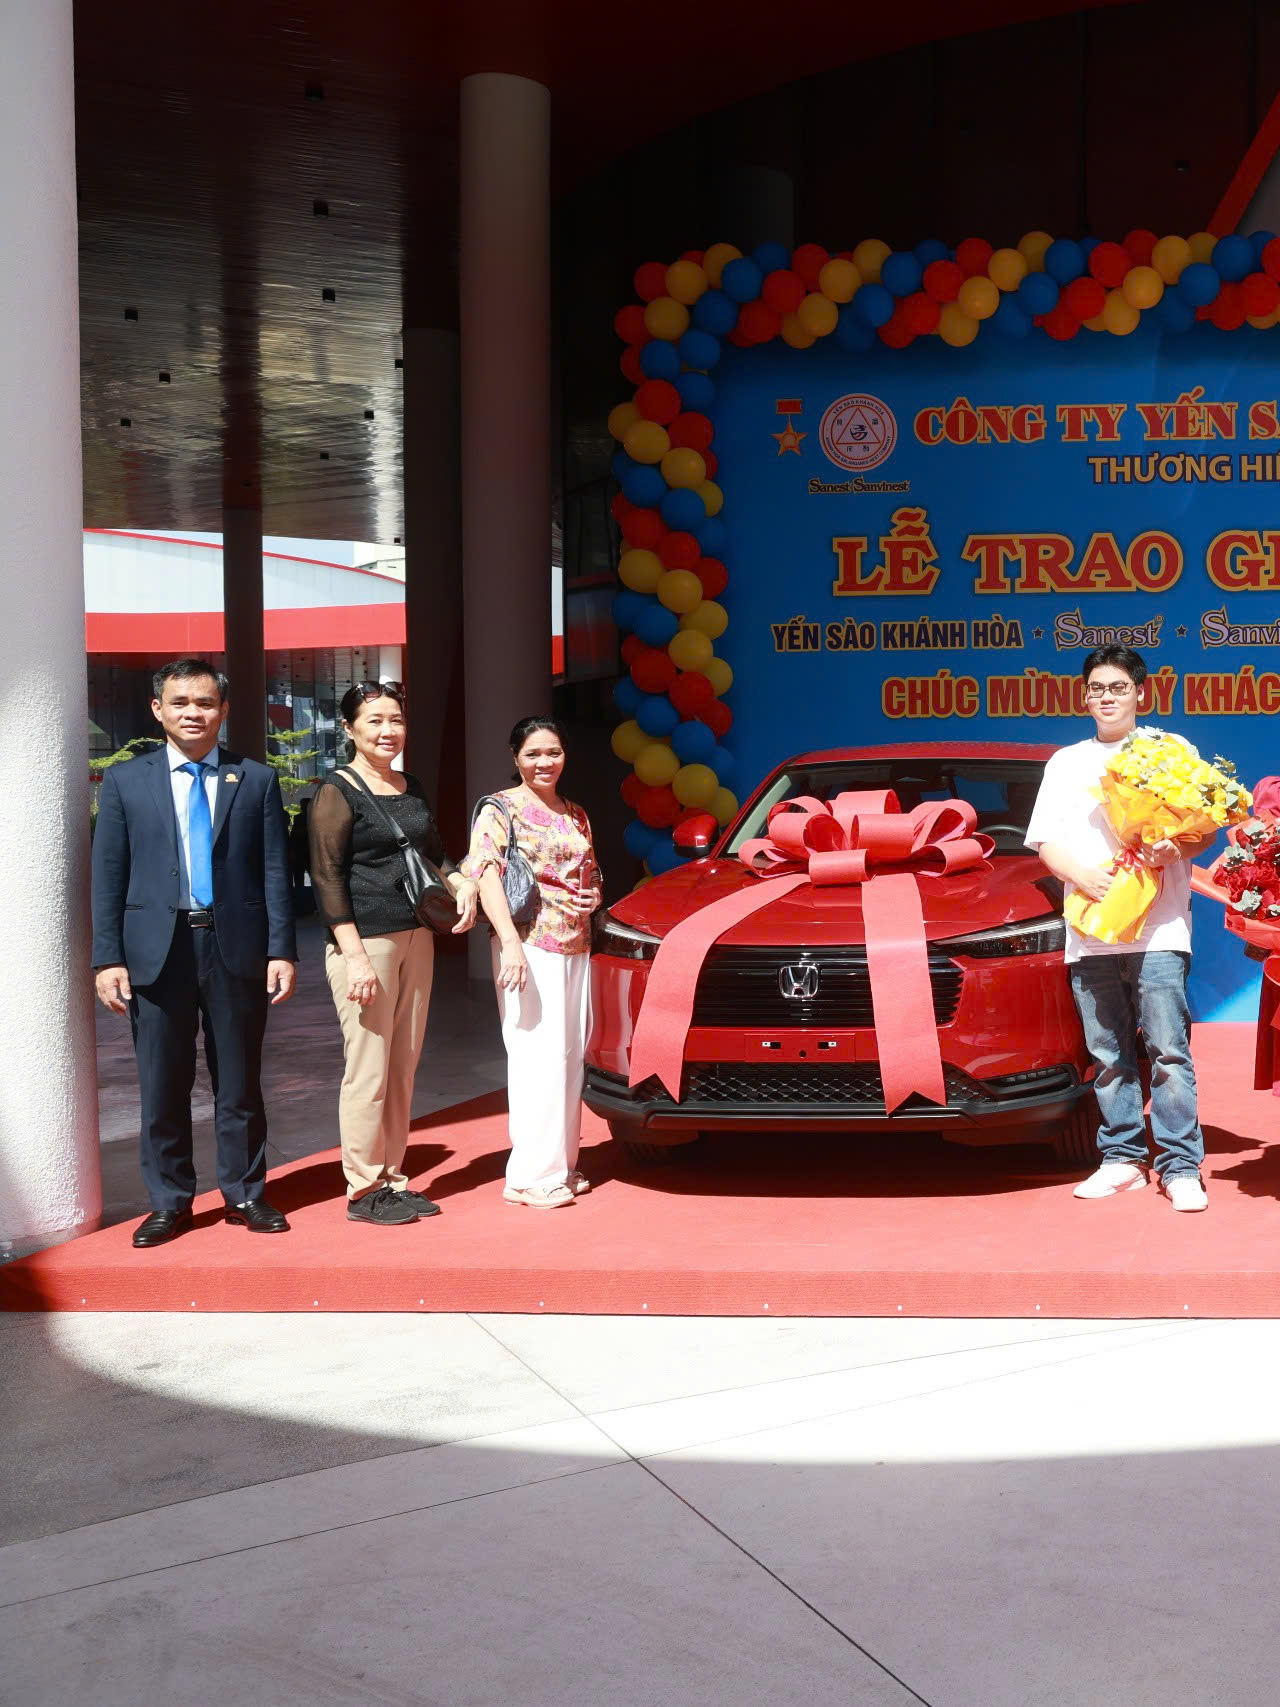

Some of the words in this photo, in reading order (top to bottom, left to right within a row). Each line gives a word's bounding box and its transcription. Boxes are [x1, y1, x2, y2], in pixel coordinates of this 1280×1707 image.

[914, 397, 1047, 446] CÔNG
[1056, 403, 1131, 442] TY
[1136, 386, 1237, 441] YẾN
[808, 477, 850, 494] Sanest
[852, 475, 909, 493] Sanvinest
[1088, 453, 1232, 486] THƯƠNG
[832, 507, 939, 596] LỄ
[961, 530, 1184, 594] TRAO
[771, 616, 820, 652] YẾN
[826, 617, 876, 650] SÀO
[881, 616, 966, 650] KHÁNH
[972, 614, 1024, 649] HÒA
[881, 669, 980, 720] CHÚC
[986, 668, 1088, 718] MỪNG
